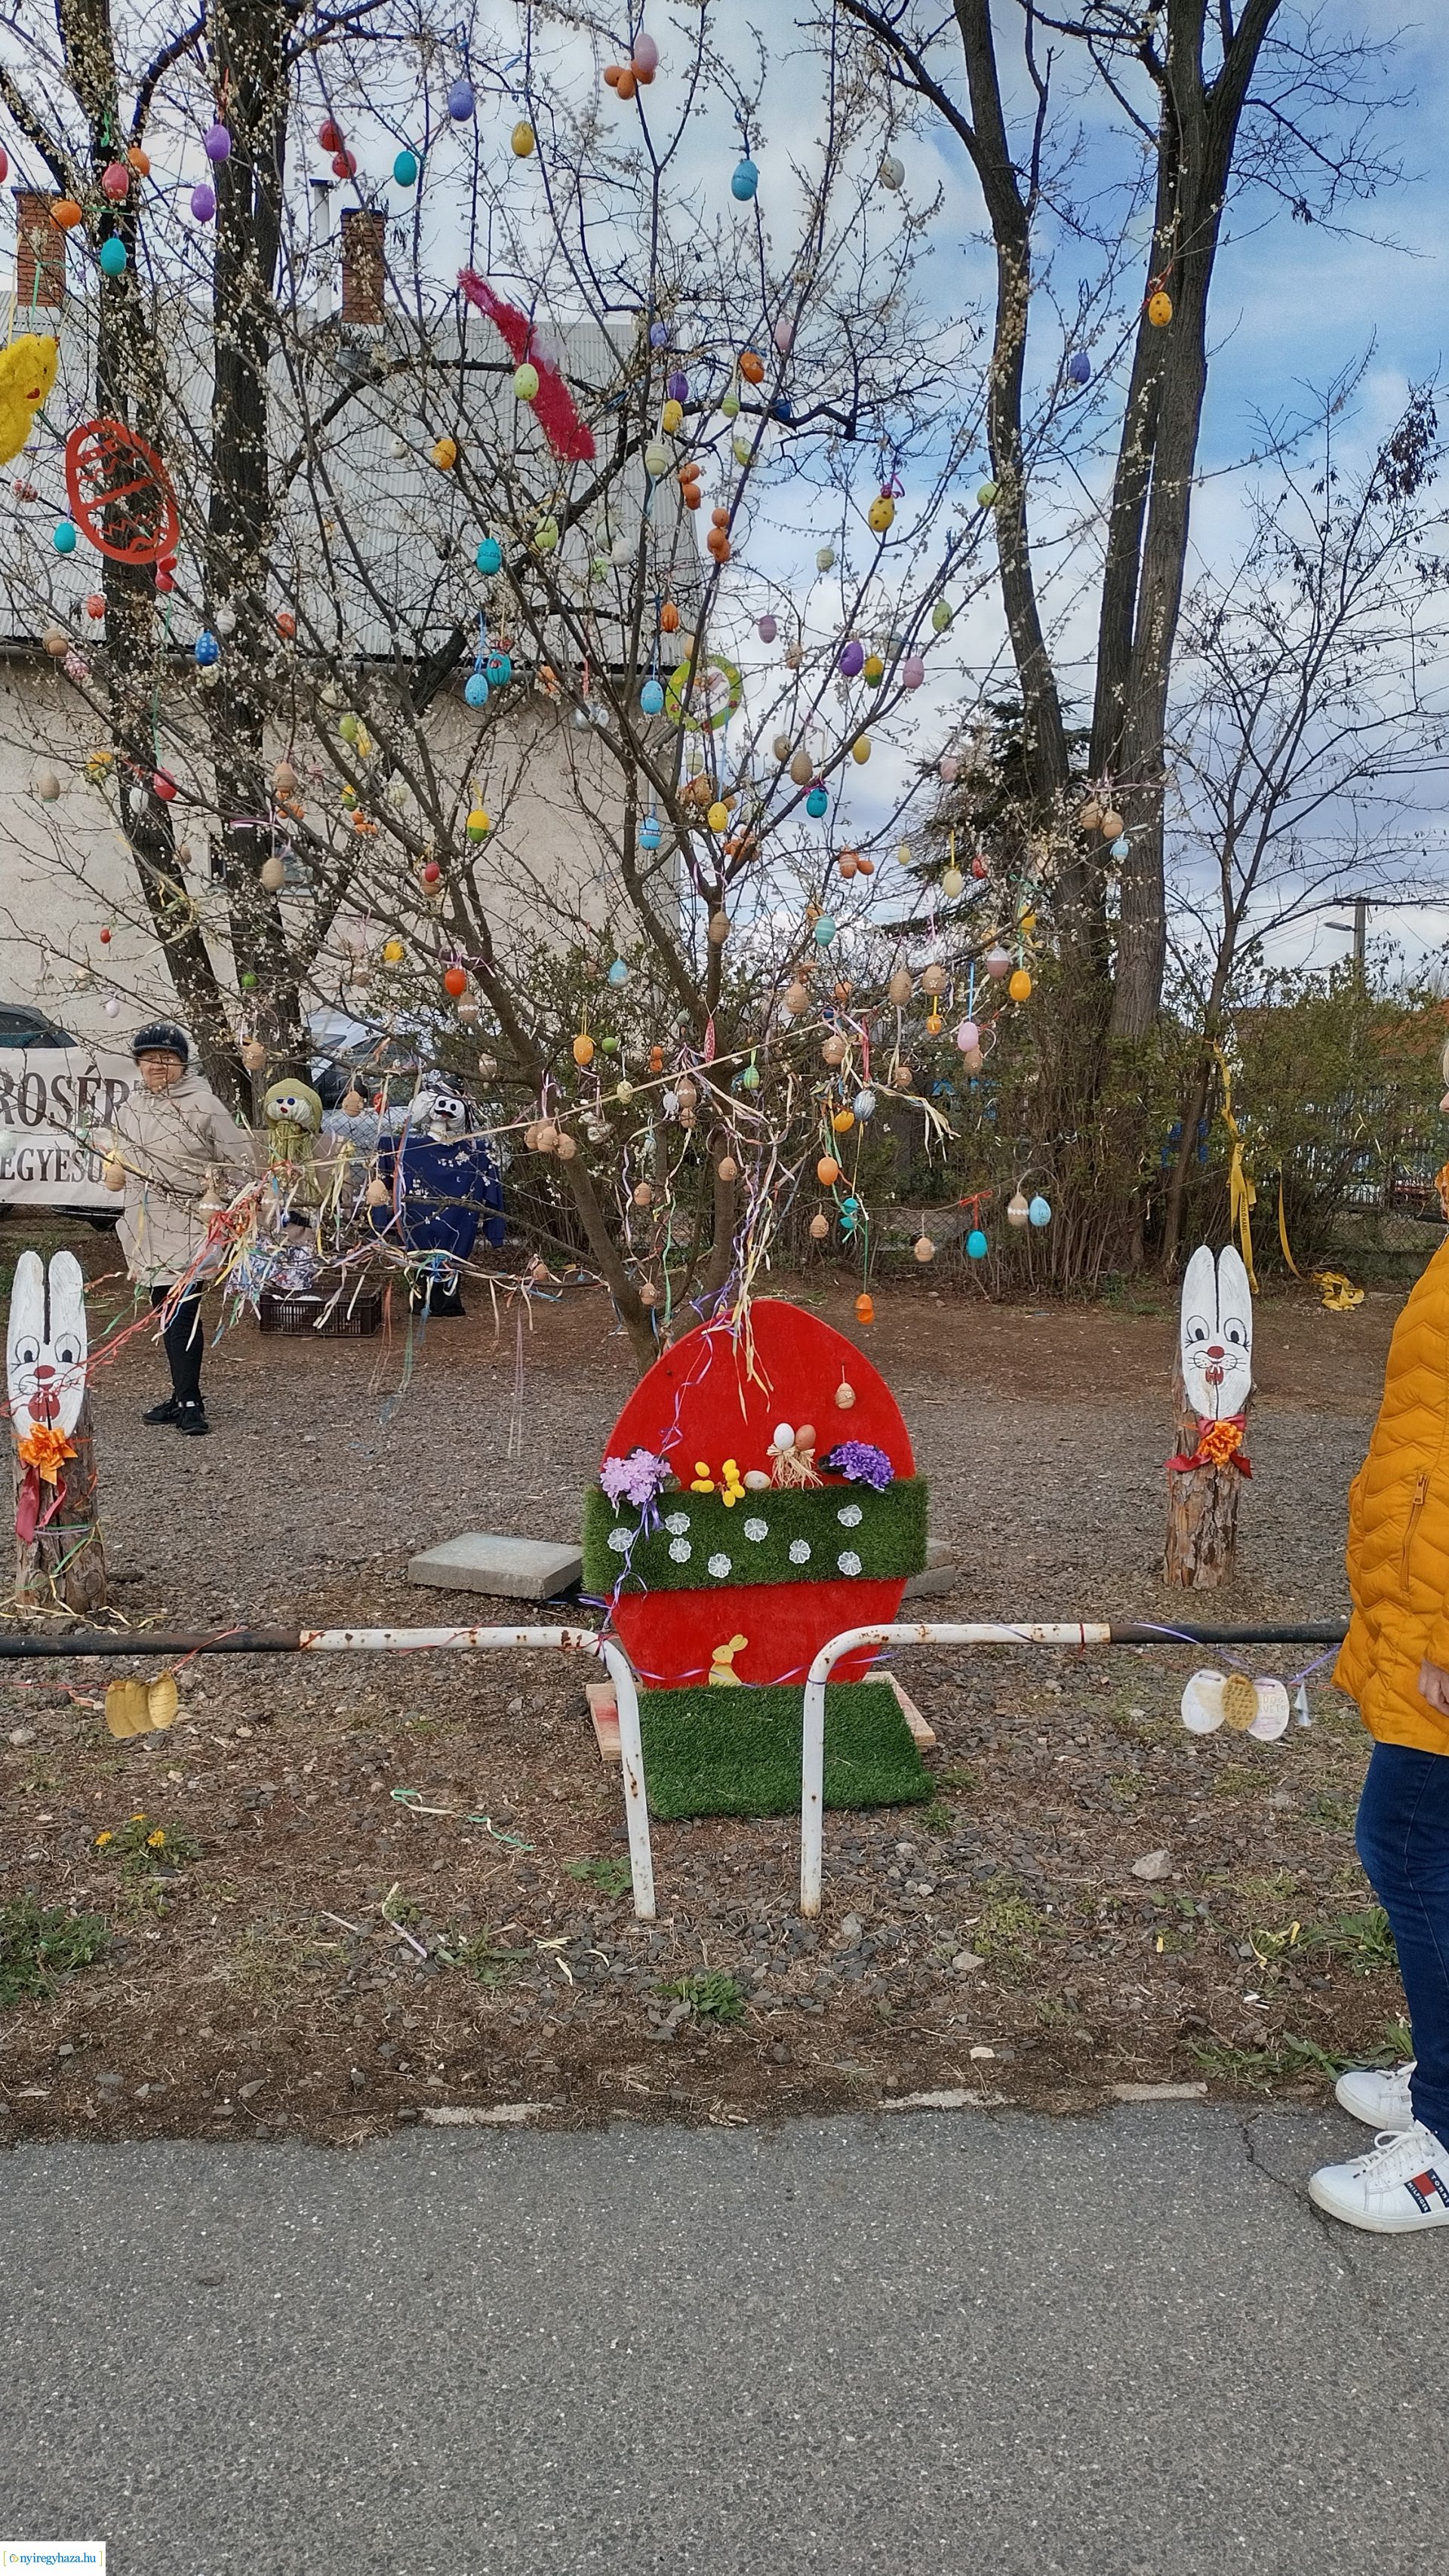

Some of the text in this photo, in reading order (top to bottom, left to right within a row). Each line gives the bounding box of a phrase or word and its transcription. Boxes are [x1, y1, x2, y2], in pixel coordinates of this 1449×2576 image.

[0, 1065, 140, 1128] ROSÉR
[1407, 2182, 1429, 2211] HILFIGER
[1431, 2174, 1449, 2203] TOMMY
